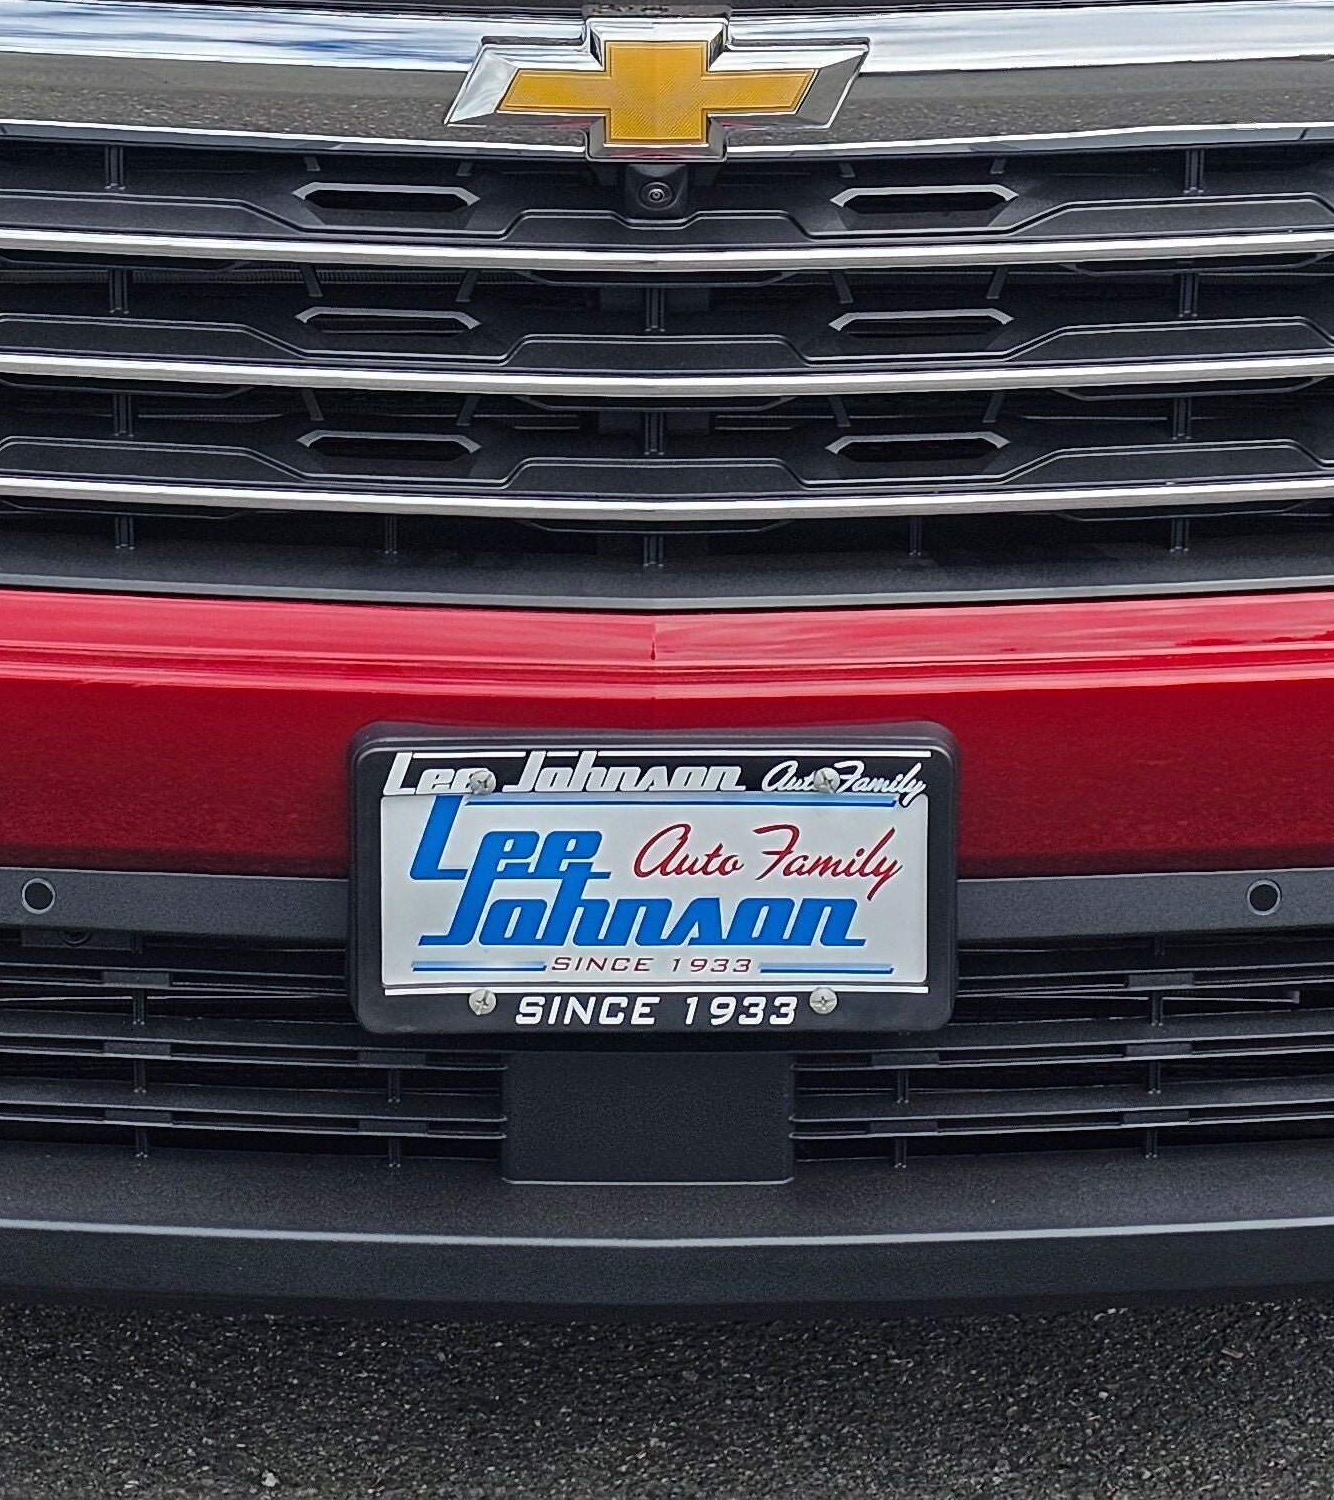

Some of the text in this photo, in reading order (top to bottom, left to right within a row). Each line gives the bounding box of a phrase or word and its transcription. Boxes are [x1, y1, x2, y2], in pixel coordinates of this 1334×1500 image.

[383, 750, 927, 807] Lee Johnson Aut Family
[410, 794, 611, 881] Lee
[633, 823, 903, 901] Auto Family
[419, 863, 867, 947] Johnson
[551, 956, 753, 973] SINCE 1933
[515, 996, 798, 1025] SINCE 1933
